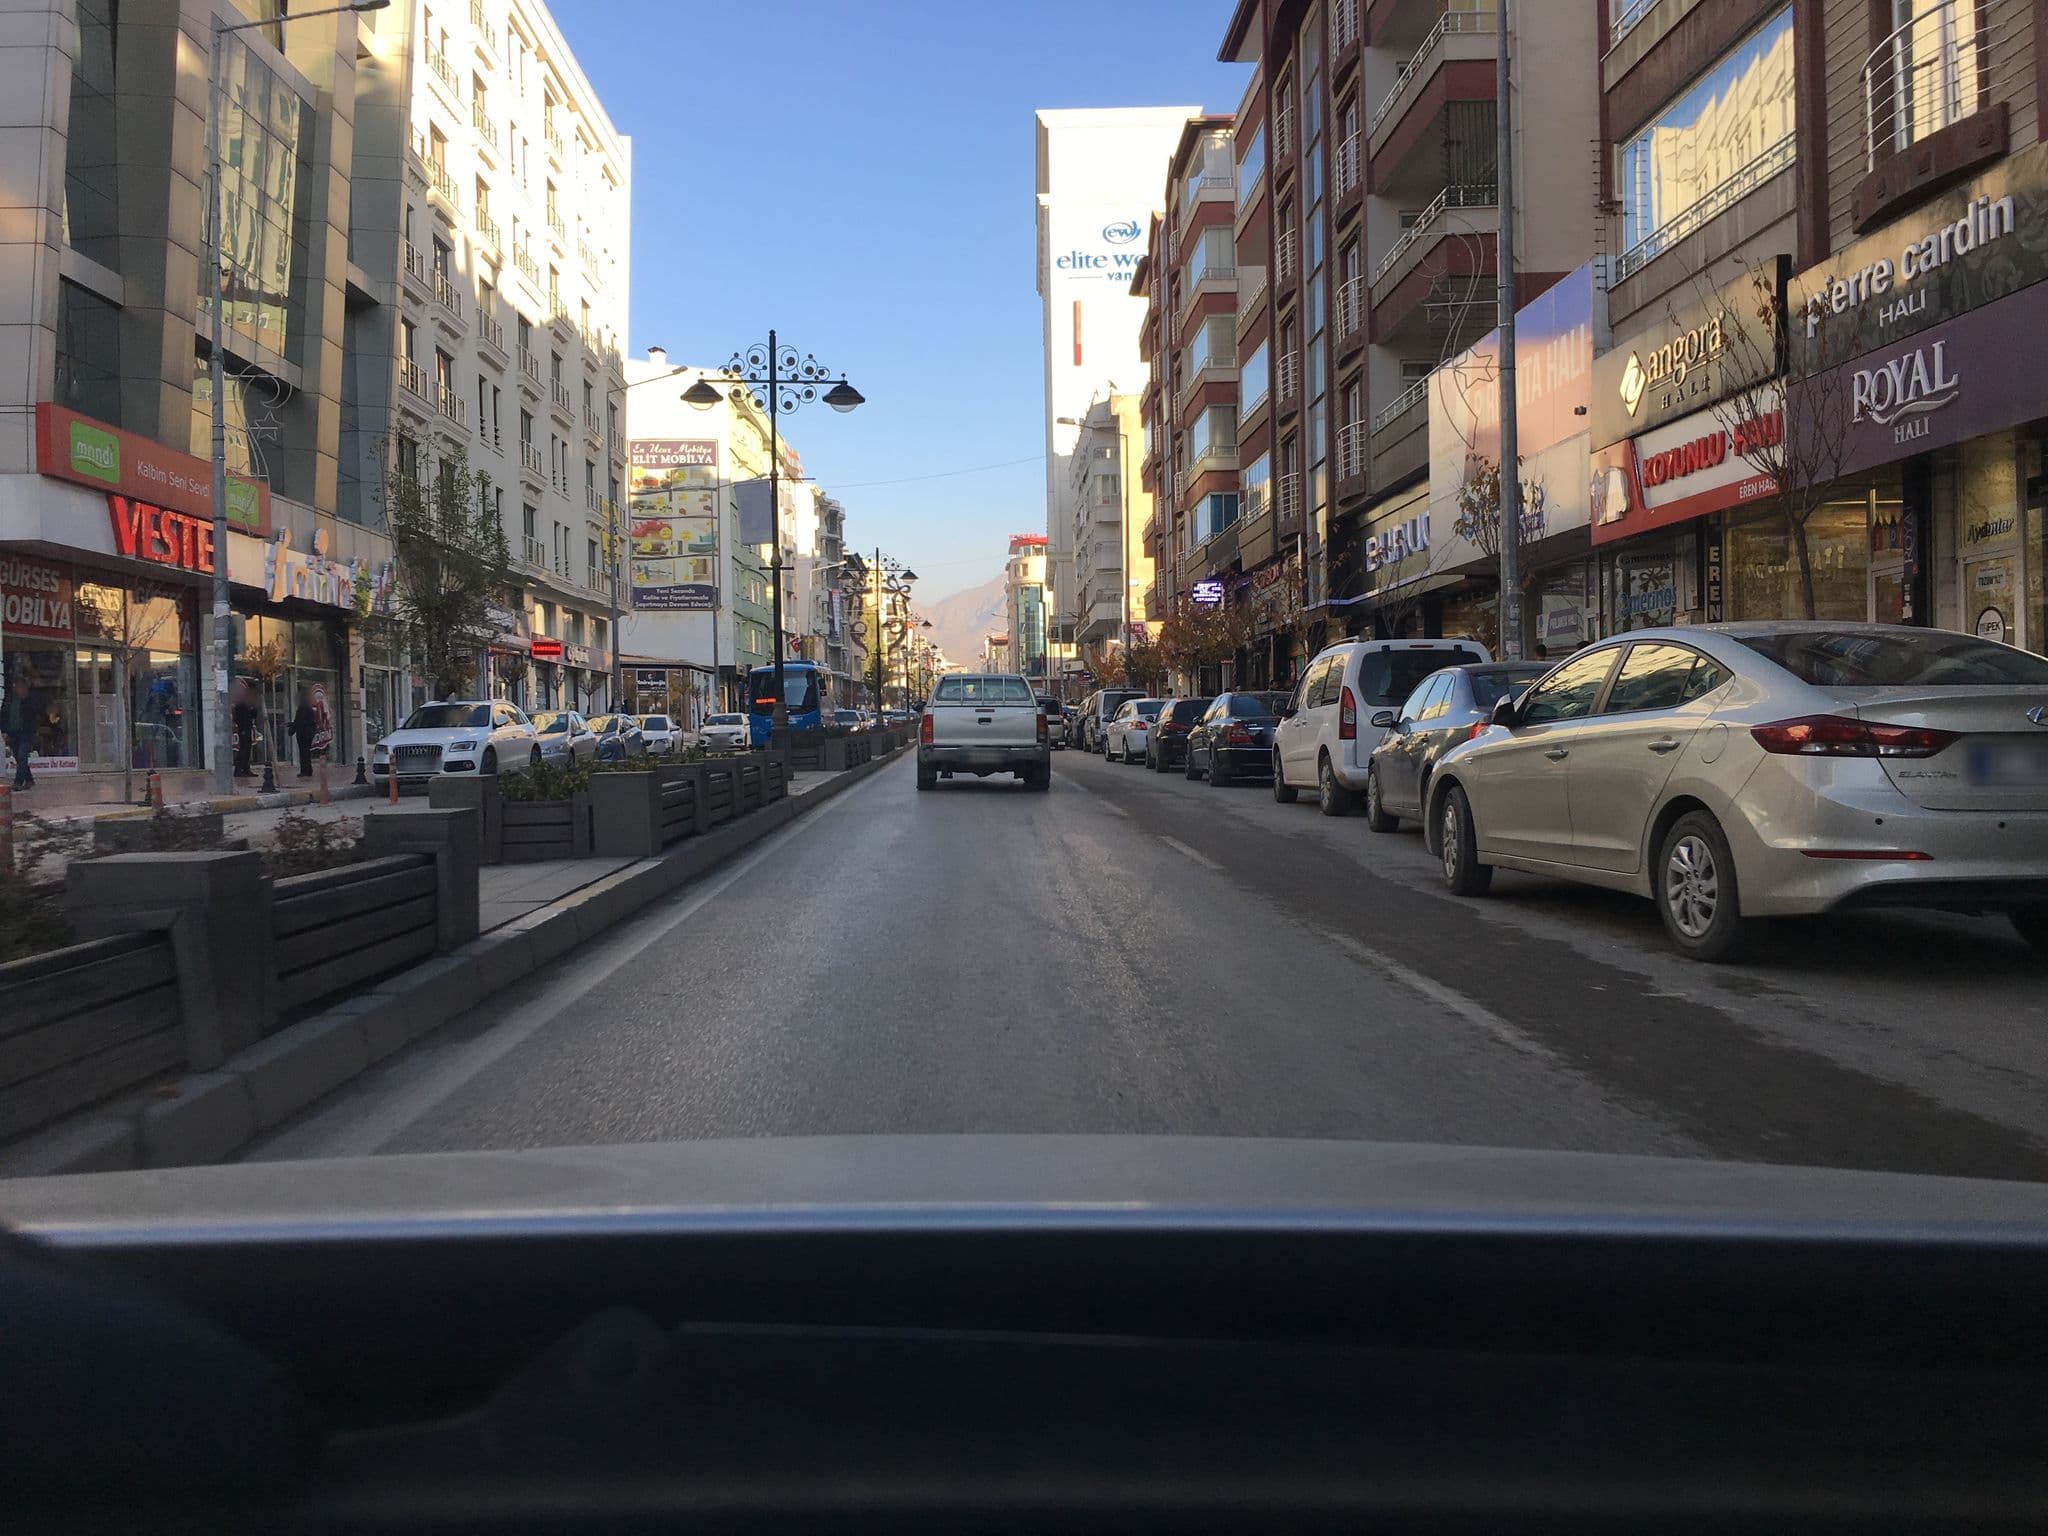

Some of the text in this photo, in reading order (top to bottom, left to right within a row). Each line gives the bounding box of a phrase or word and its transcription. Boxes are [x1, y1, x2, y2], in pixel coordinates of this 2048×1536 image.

[1056, 250, 1108, 269] elite
[1901, 194, 2014, 281] cardin
[1879, 289, 1926, 328] HALI
[1647, 316, 1724, 387] angora
[1851, 340, 1959, 424] ROYAL
[632, 453, 713, 464] ELİT MOBİLYA
[1643, 430, 1726, 489] KOYUNLU
[1894, 417, 1930, 444] HALI
[107, 495, 231, 577] VESTE
[0, 558, 60, 593] GÜRSES
[1709, 546, 1720, 622] EREN
